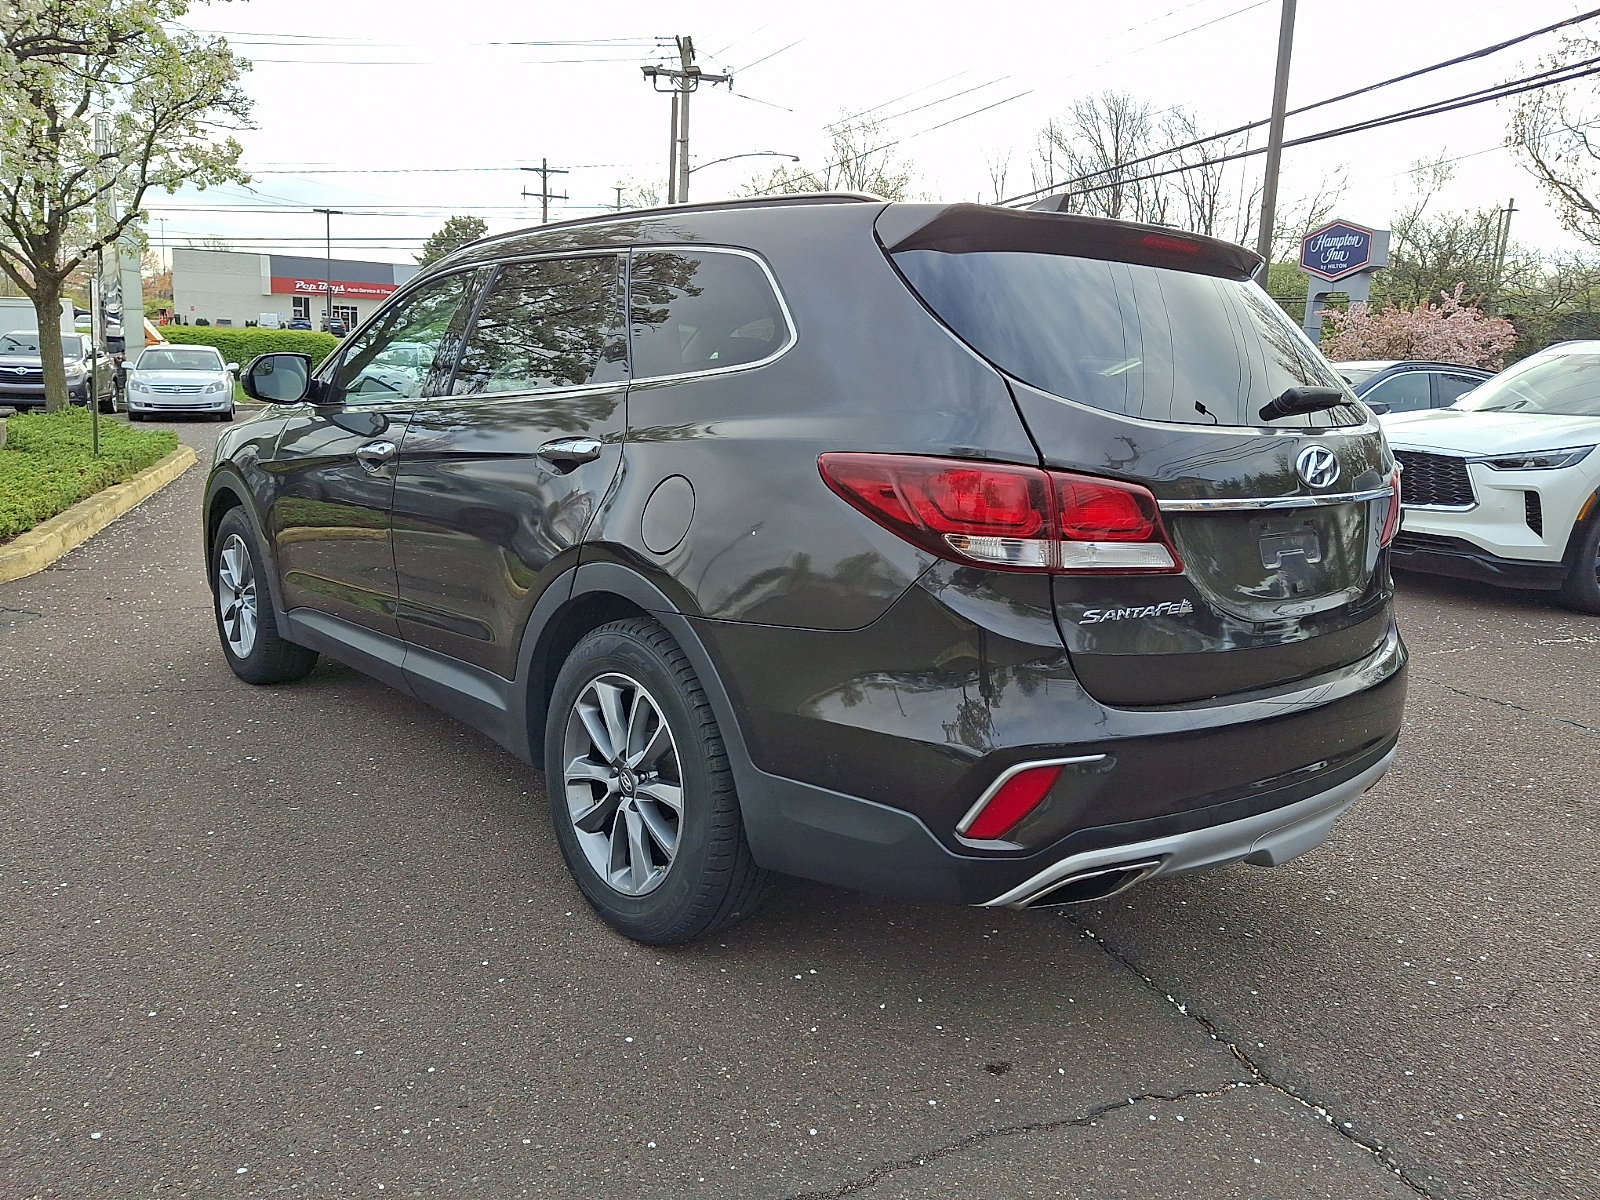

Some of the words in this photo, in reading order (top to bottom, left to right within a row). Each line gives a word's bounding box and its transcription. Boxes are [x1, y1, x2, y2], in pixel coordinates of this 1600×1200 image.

[1310, 233, 1363, 252] Hampton
[1321, 247, 1349, 263] Inn
[295, 281, 317, 292] Pep
